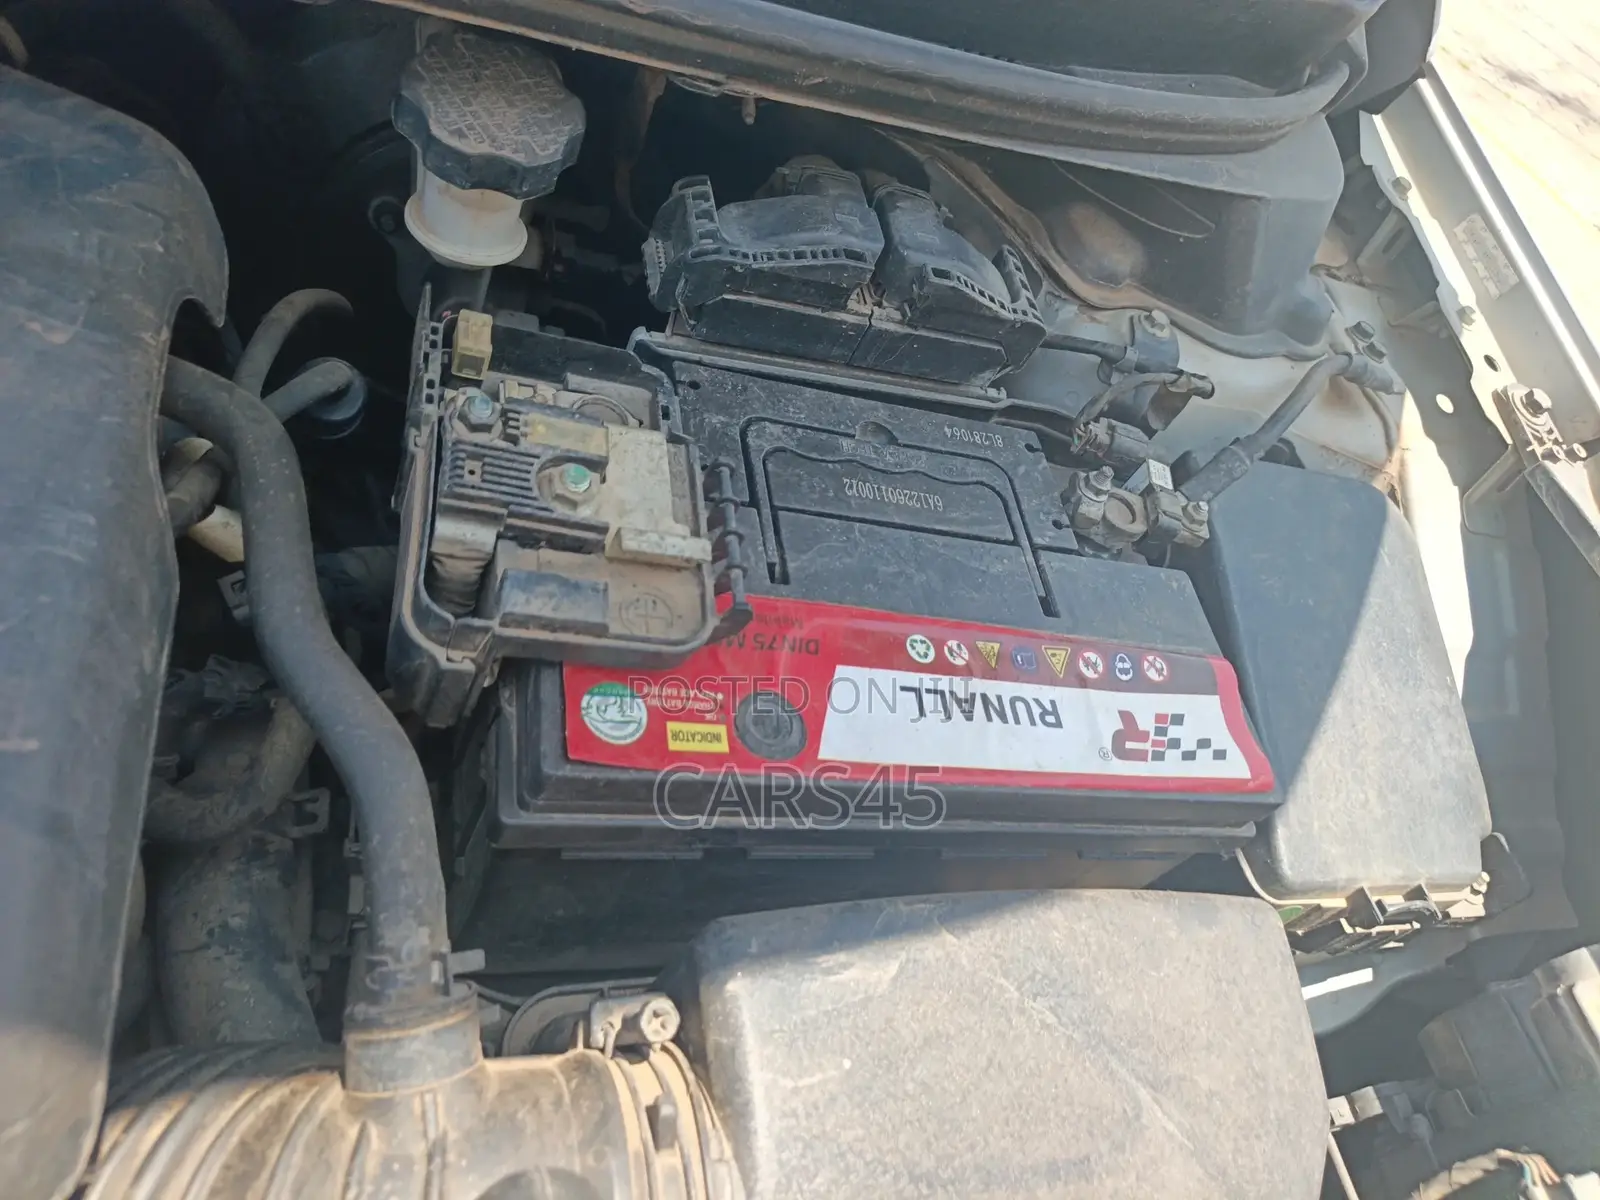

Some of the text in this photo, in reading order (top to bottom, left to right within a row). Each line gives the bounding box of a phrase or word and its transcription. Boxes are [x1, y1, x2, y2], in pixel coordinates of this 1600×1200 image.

[943, 425, 1004, 448] 8L281064
[752, 632, 820, 656] DIN75
[899, 685, 1064, 729] RUNALL
[670, 729, 723, 744] INDICATOR
